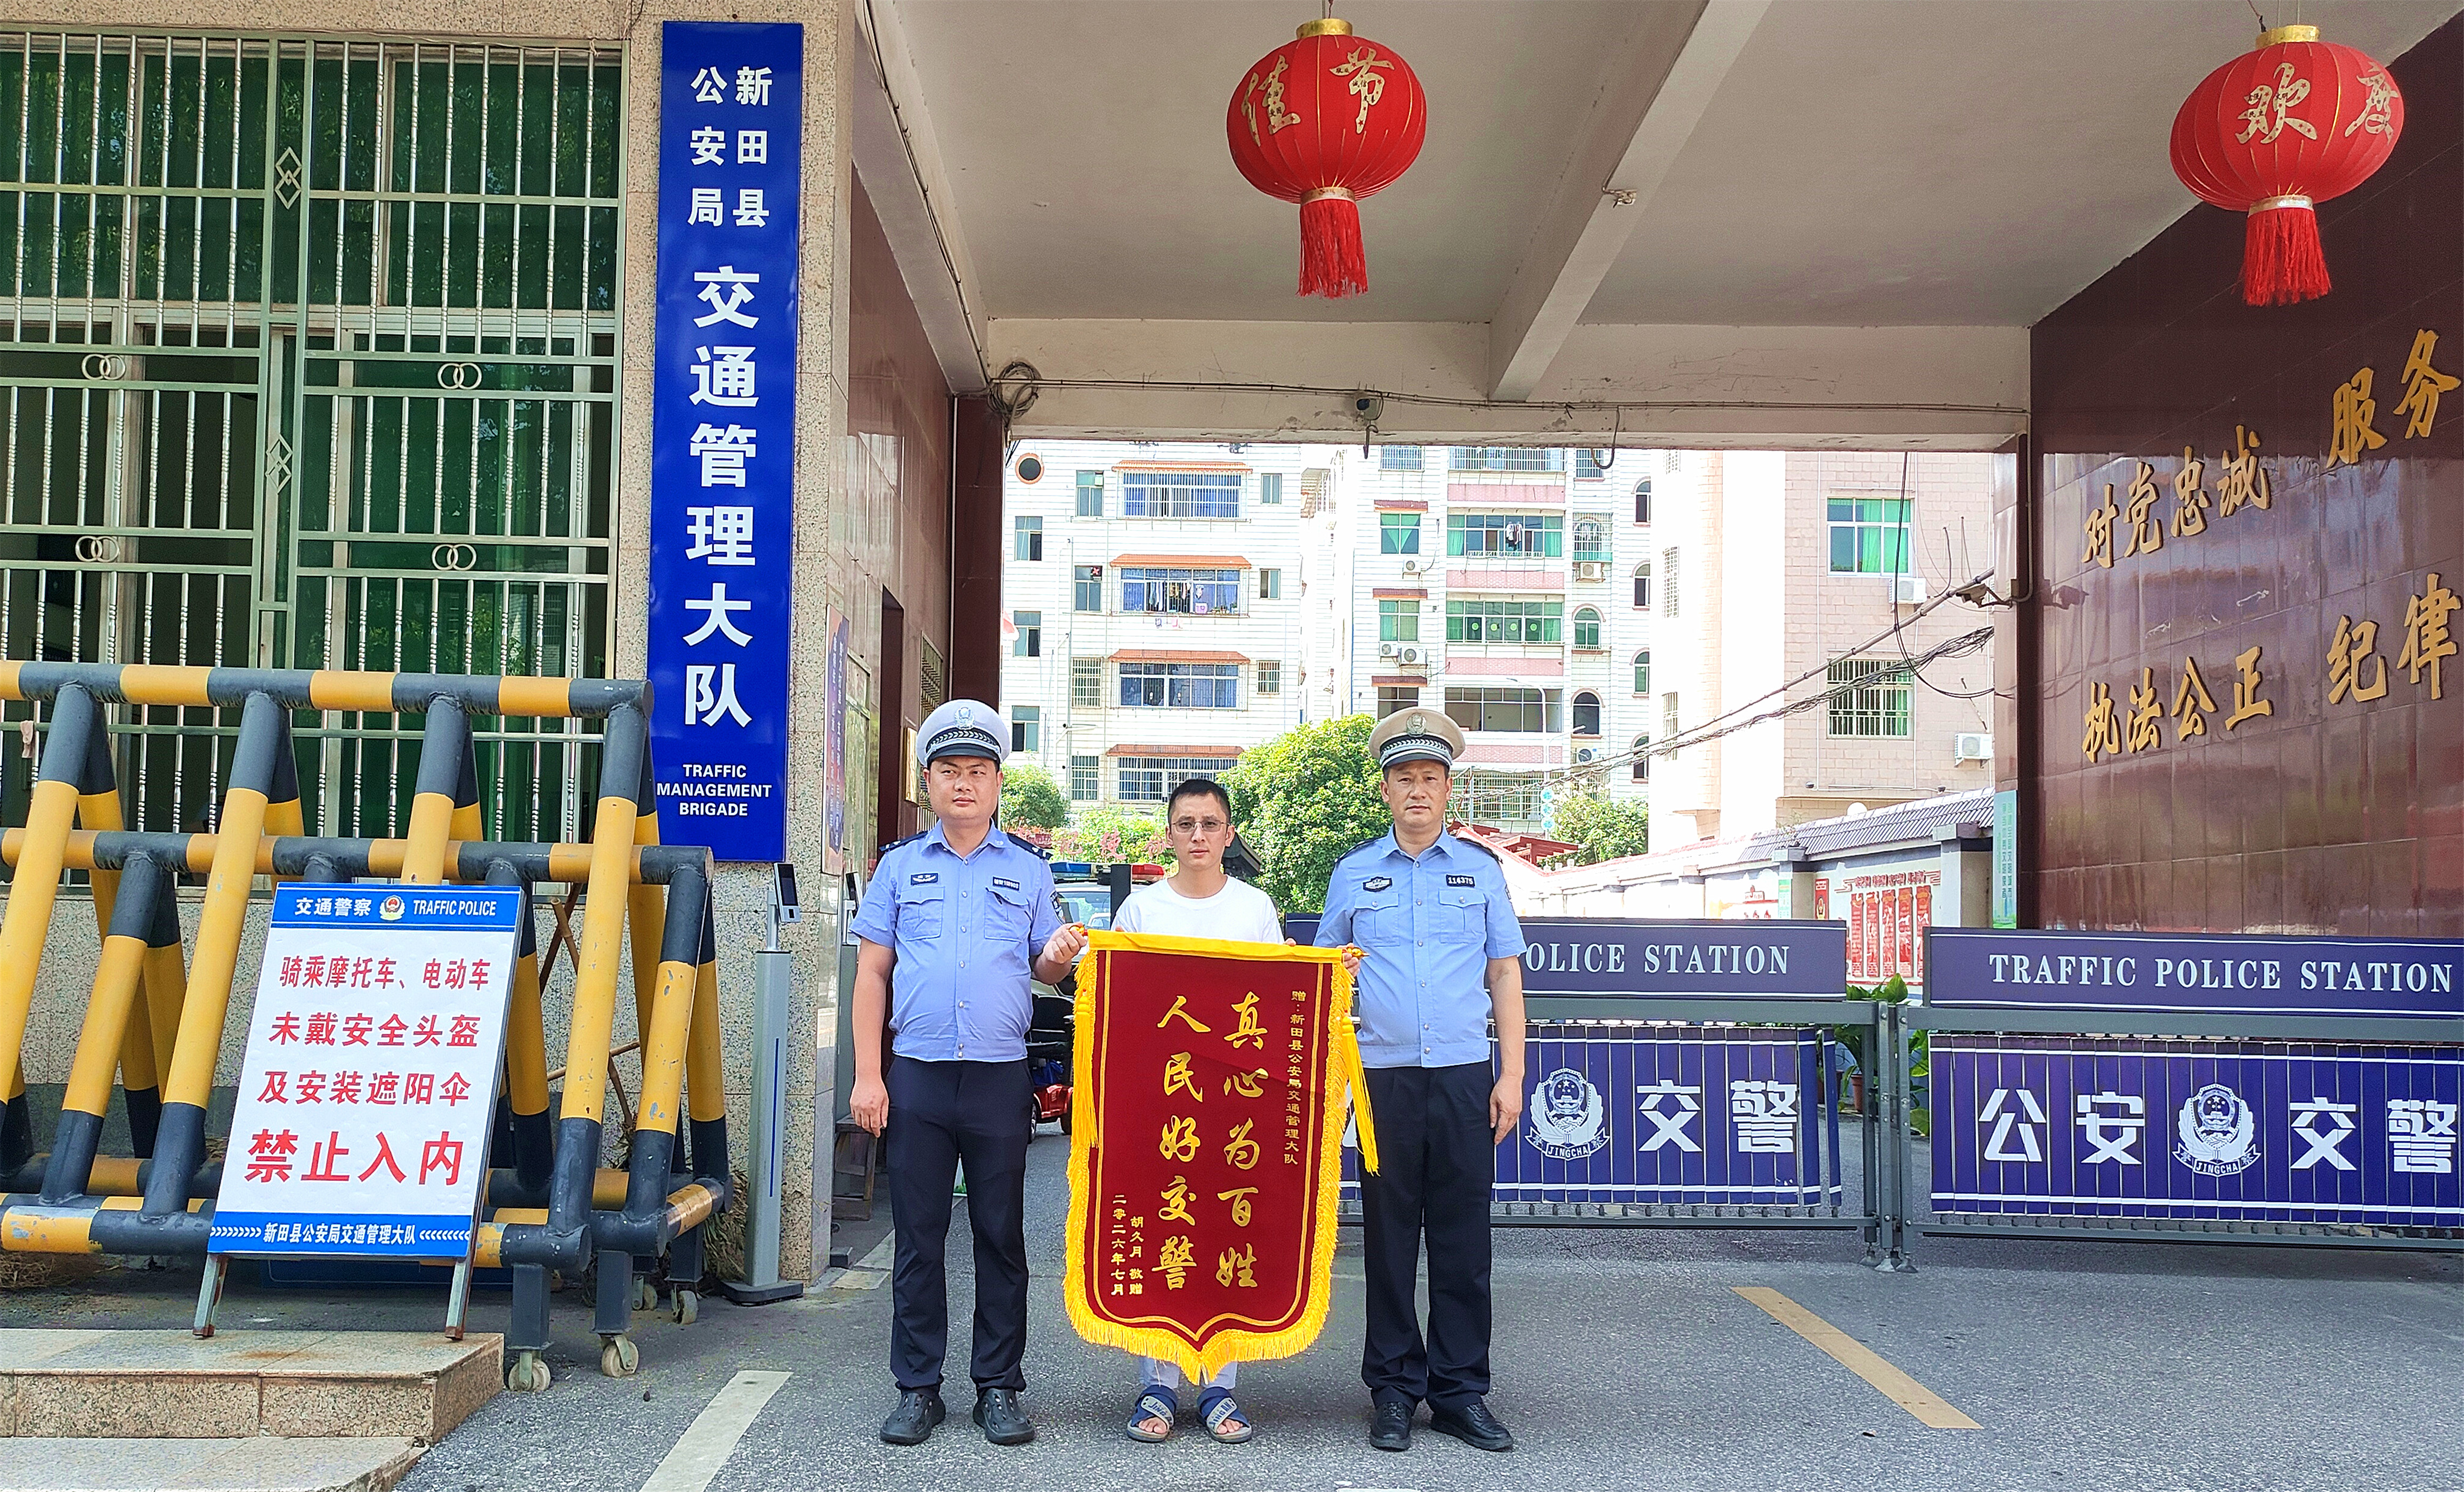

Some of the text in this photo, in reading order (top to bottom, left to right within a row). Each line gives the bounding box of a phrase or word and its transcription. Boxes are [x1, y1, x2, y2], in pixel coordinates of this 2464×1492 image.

[1241, 46, 1395, 148] 佳节
[2235, 62, 2399, 145] 欢度
[687, 66, 727, 226] 公安局
[732, 66, 773, 227] 新田县
[2081, 329, 2462, 569] 对党忠诚 服务
[683, 265, 760, 728] 交通管理大队
[2081, 573, 2461, 764] 执法公正 纪律
[656, 783, 772, 797] MANAGEMENT
[683, 764, 747, 778] TRAFFIC
[679, 802, 748, 816] BRIGADE
[294, 897, 371, 917] 交通警察
[414, 899, 496, 916] TRAFFIC POLICE
[279, 955, 491, 991] 骑乘摩托车、电动车
[1525, 942, 1789, 975] OLICE STATION
[1989, 954, 2452, 993] TRAFFIC POLICE STATION
[269, 1011, 481, 1048] 未戴安全头盔
[257, 1070, 471, 1106] 及安装遮阳伞
[1151, 995, 1211, 1291] 人民好交警
[1216, 991, 1269, 1288] 真心为百姓
[1636, 1080, 1798, 1153] 交警
[1979, 1088, 2457, 1173] 公安 交警
[244, 1129, 464, 1185] 禁止入内
[1548, 1146, 1588, 1157] JINGCHA
[2196, 1163, 2238, 1174] JINGCHA
[263, 1222, 416, 1245] 新田县公安局交通管理大队
[1111, 1195, 1126, 1295] 二零二六年七月
[1129, 1216, 1144, 1295] 胡久月 敬赠
